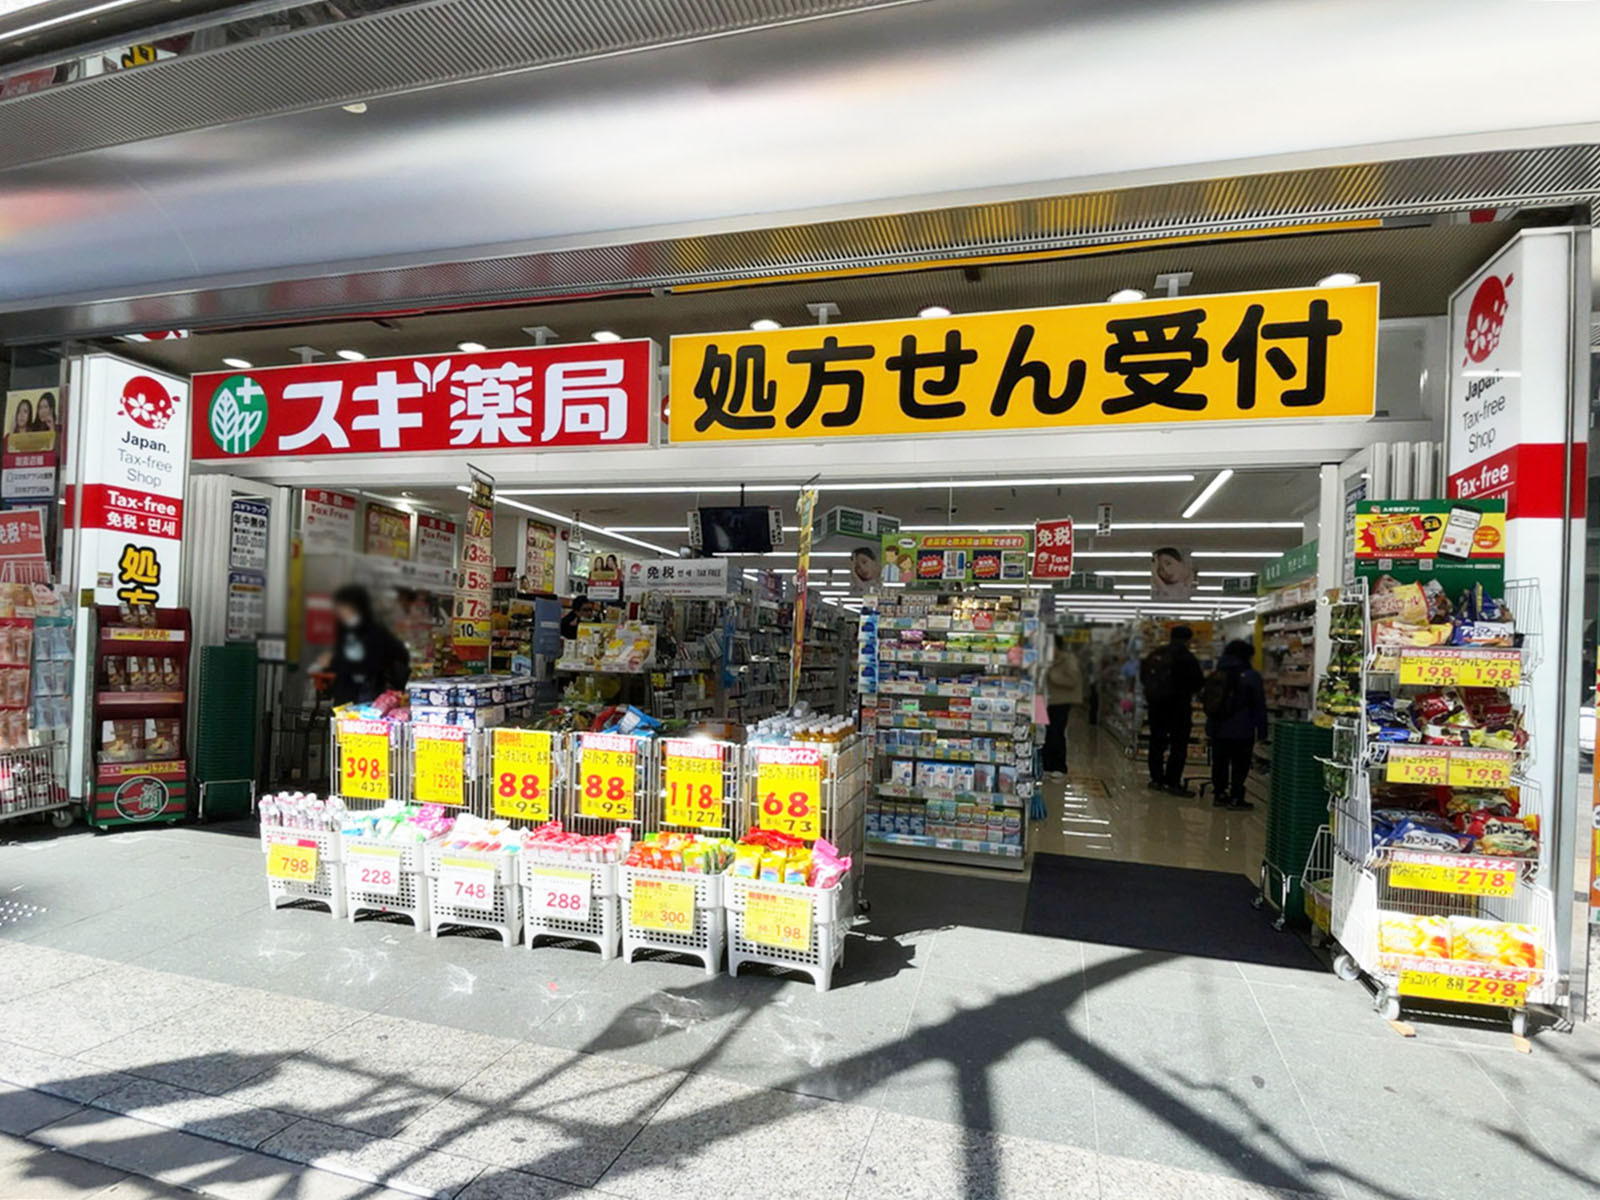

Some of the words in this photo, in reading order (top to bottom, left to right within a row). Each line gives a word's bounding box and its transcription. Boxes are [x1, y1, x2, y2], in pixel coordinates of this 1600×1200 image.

[693, 300, 1343, 432] 処方せん受付
[279, 359, 628, 451] スギ薬局
[1462, 394, 1506, 432] Tax-free
[1468, 426, 1496, 454] Shop
[117, 448, 172, 473] Tax-free
[126, 467, 162, 488] Shop
[1456, 462, 1509, 499] Tax-free
[107, 490, 176, 516] Tax-free
[1038, 527, 1071, 547] 免税
[1048, 563, 1070, 573] Free
[1051, 554, 1068, 563] Tax
[647, 566, 675, 579] 免税
[784, 820, 812, 832] 73
